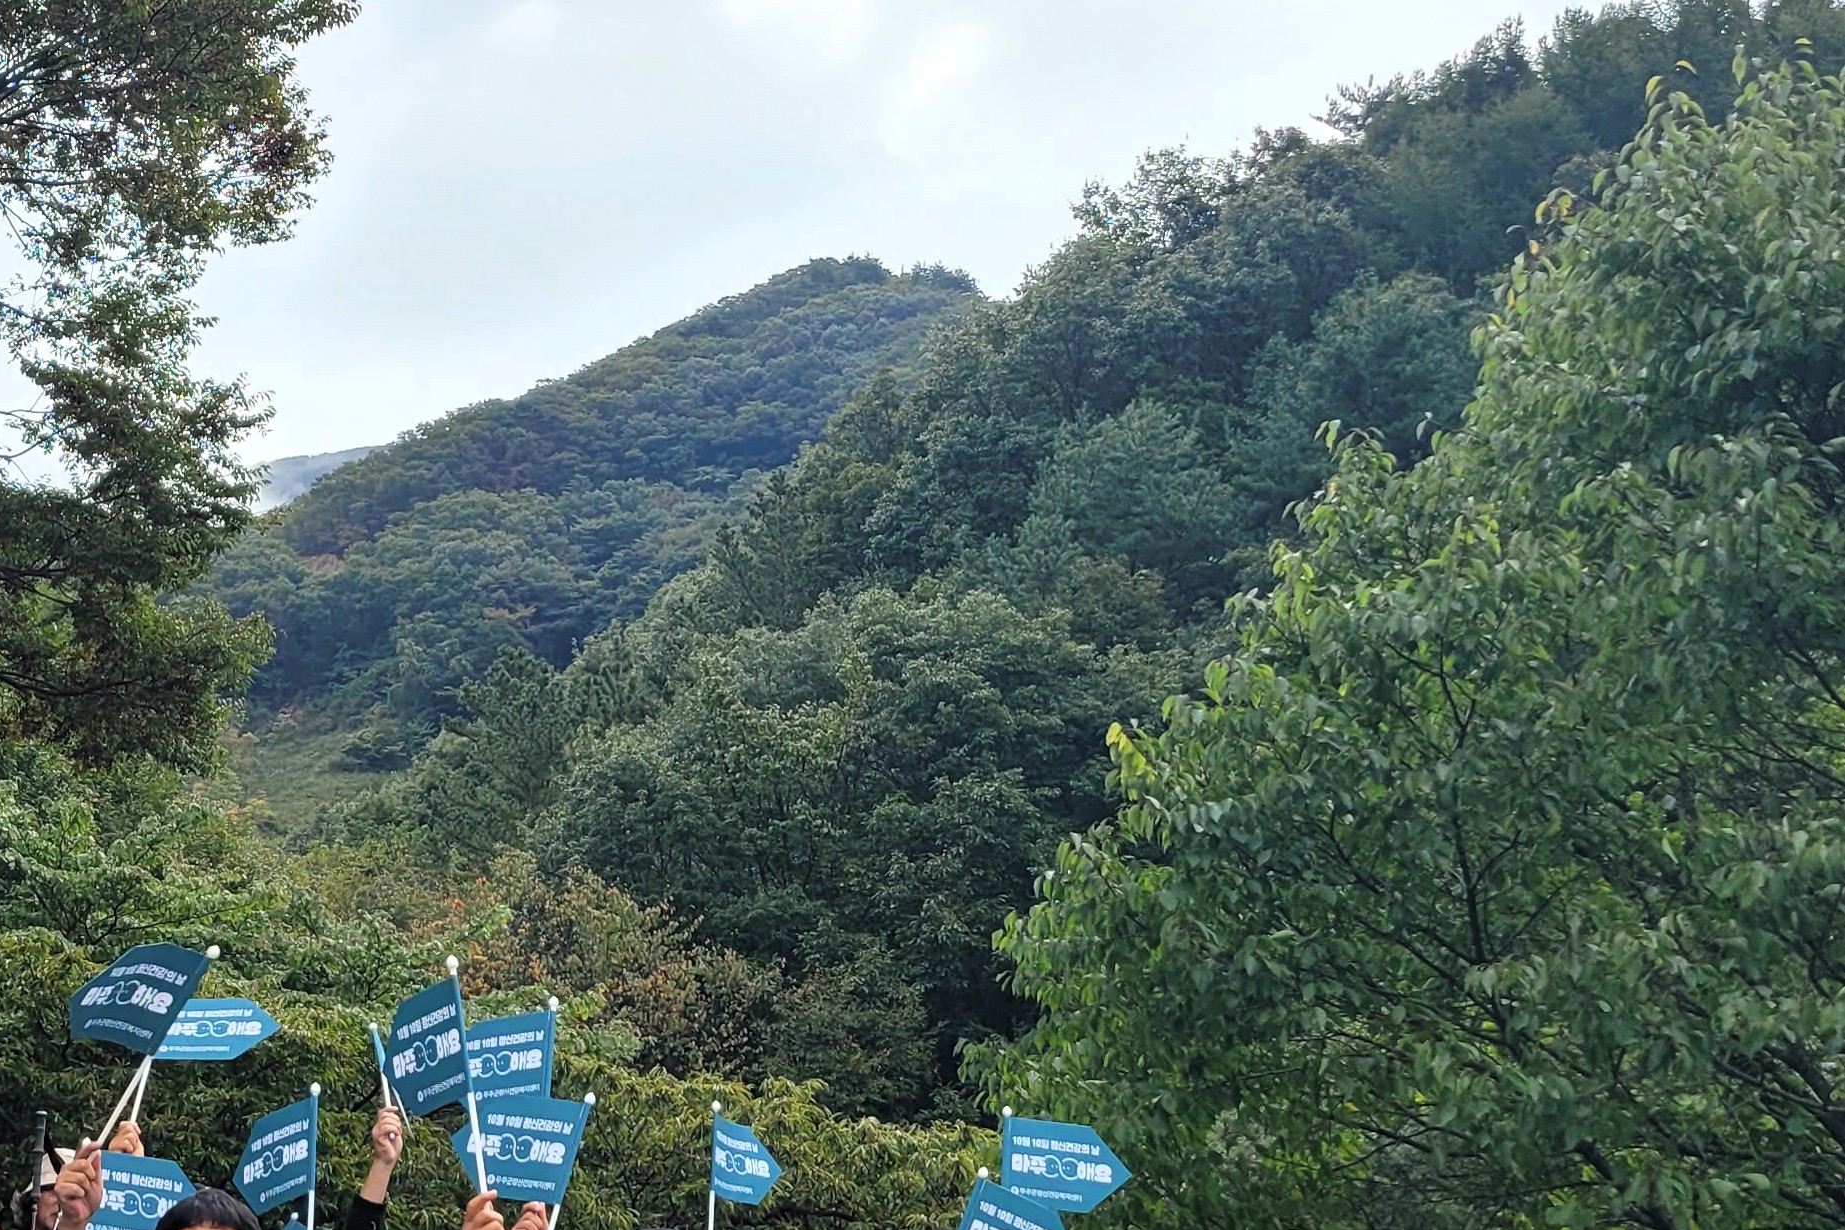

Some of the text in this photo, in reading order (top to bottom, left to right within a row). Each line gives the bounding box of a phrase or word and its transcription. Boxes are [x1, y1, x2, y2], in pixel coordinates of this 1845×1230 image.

[487, 1113, 573, 1135] 10월 10일 정신건강의 날
[1013, 1136, 1099, 1156] 10월 10일 정신건강의 날
[112, 1171, 130, 1183] 10일
[132, 1174, 172, 1191] 정신건강의
[174, 1181, 183, 1193] 날
[980, 1201, 997, 1217] 10월
[997, 1209, 1014, 1225] 10일
